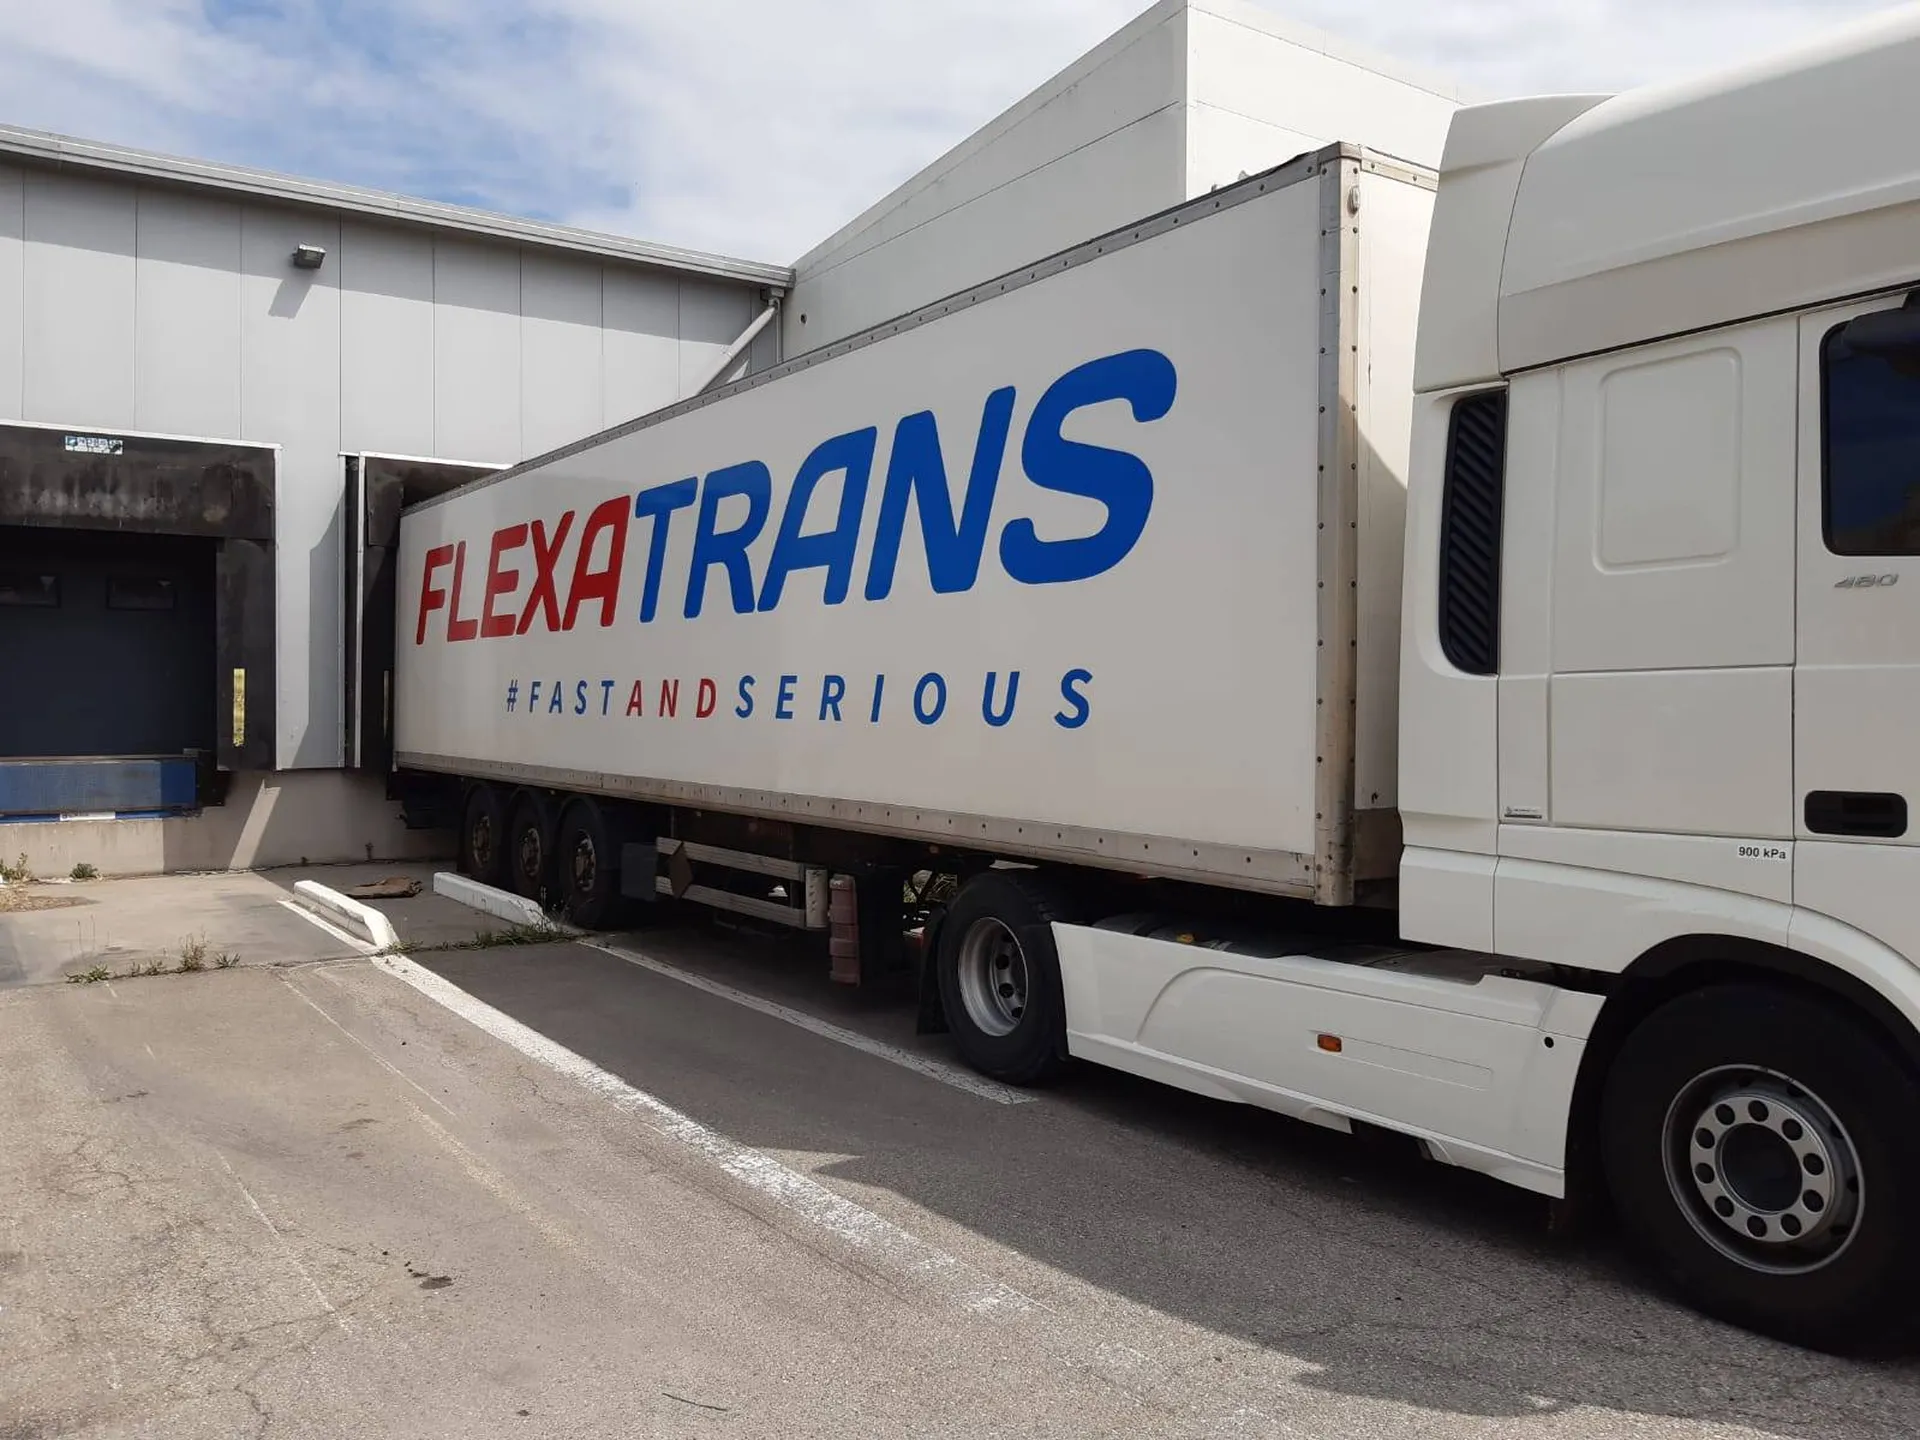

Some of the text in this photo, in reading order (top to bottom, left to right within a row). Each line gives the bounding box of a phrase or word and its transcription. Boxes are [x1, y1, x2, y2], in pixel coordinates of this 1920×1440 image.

[416, 348, 1178, 646] FLEXATRANS
[507, 668, 1093, 729] #FASTANDSERIOUS
[1738, 846, 1787, 860] 900 kPa
